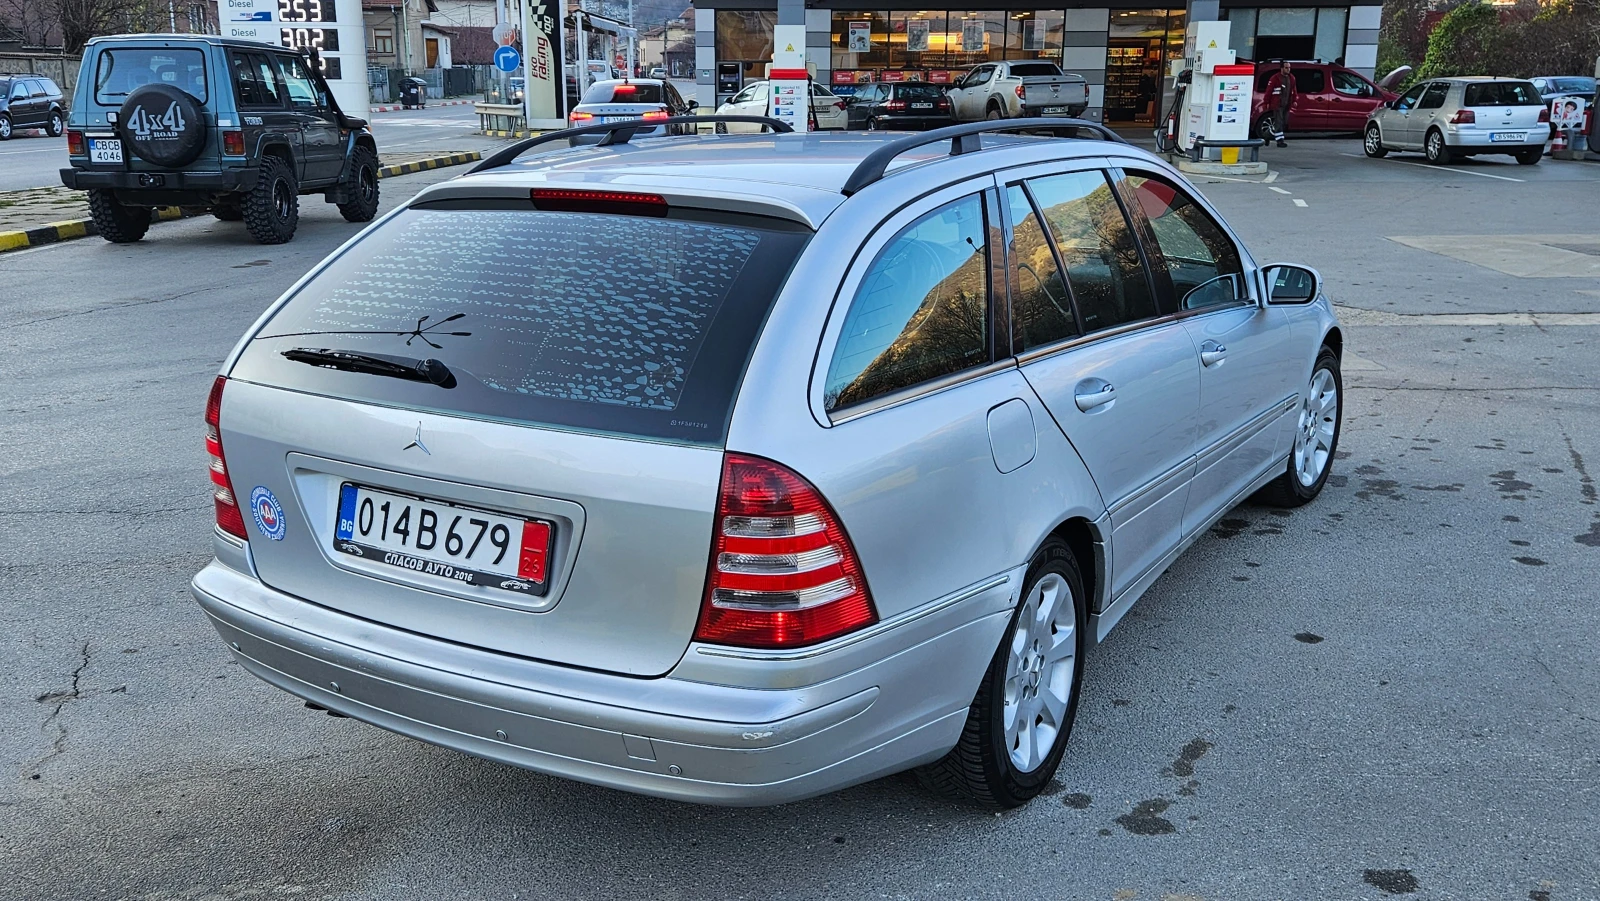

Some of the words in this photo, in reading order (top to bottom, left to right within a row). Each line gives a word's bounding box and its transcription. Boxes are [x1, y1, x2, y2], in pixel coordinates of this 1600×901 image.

[279, 0, 322, 22] 2.53
[231, 29, 257, 37] Diesel
[543, 15, 552, 35] 100
[537, 36, 549, 80] racing
[97, 151, 121, 161] 4046
[260, 504, 277, 521] AAA
[270, 494, 282, 512] CLUB
[340, 518, 353, 533] BG
[358, 497, 511, 566] 014B679
[384, 553, 424, 571] СПАСОВ
[425, 562, 454, 578] АУТО
[454, 570, 474, 582] 2016
